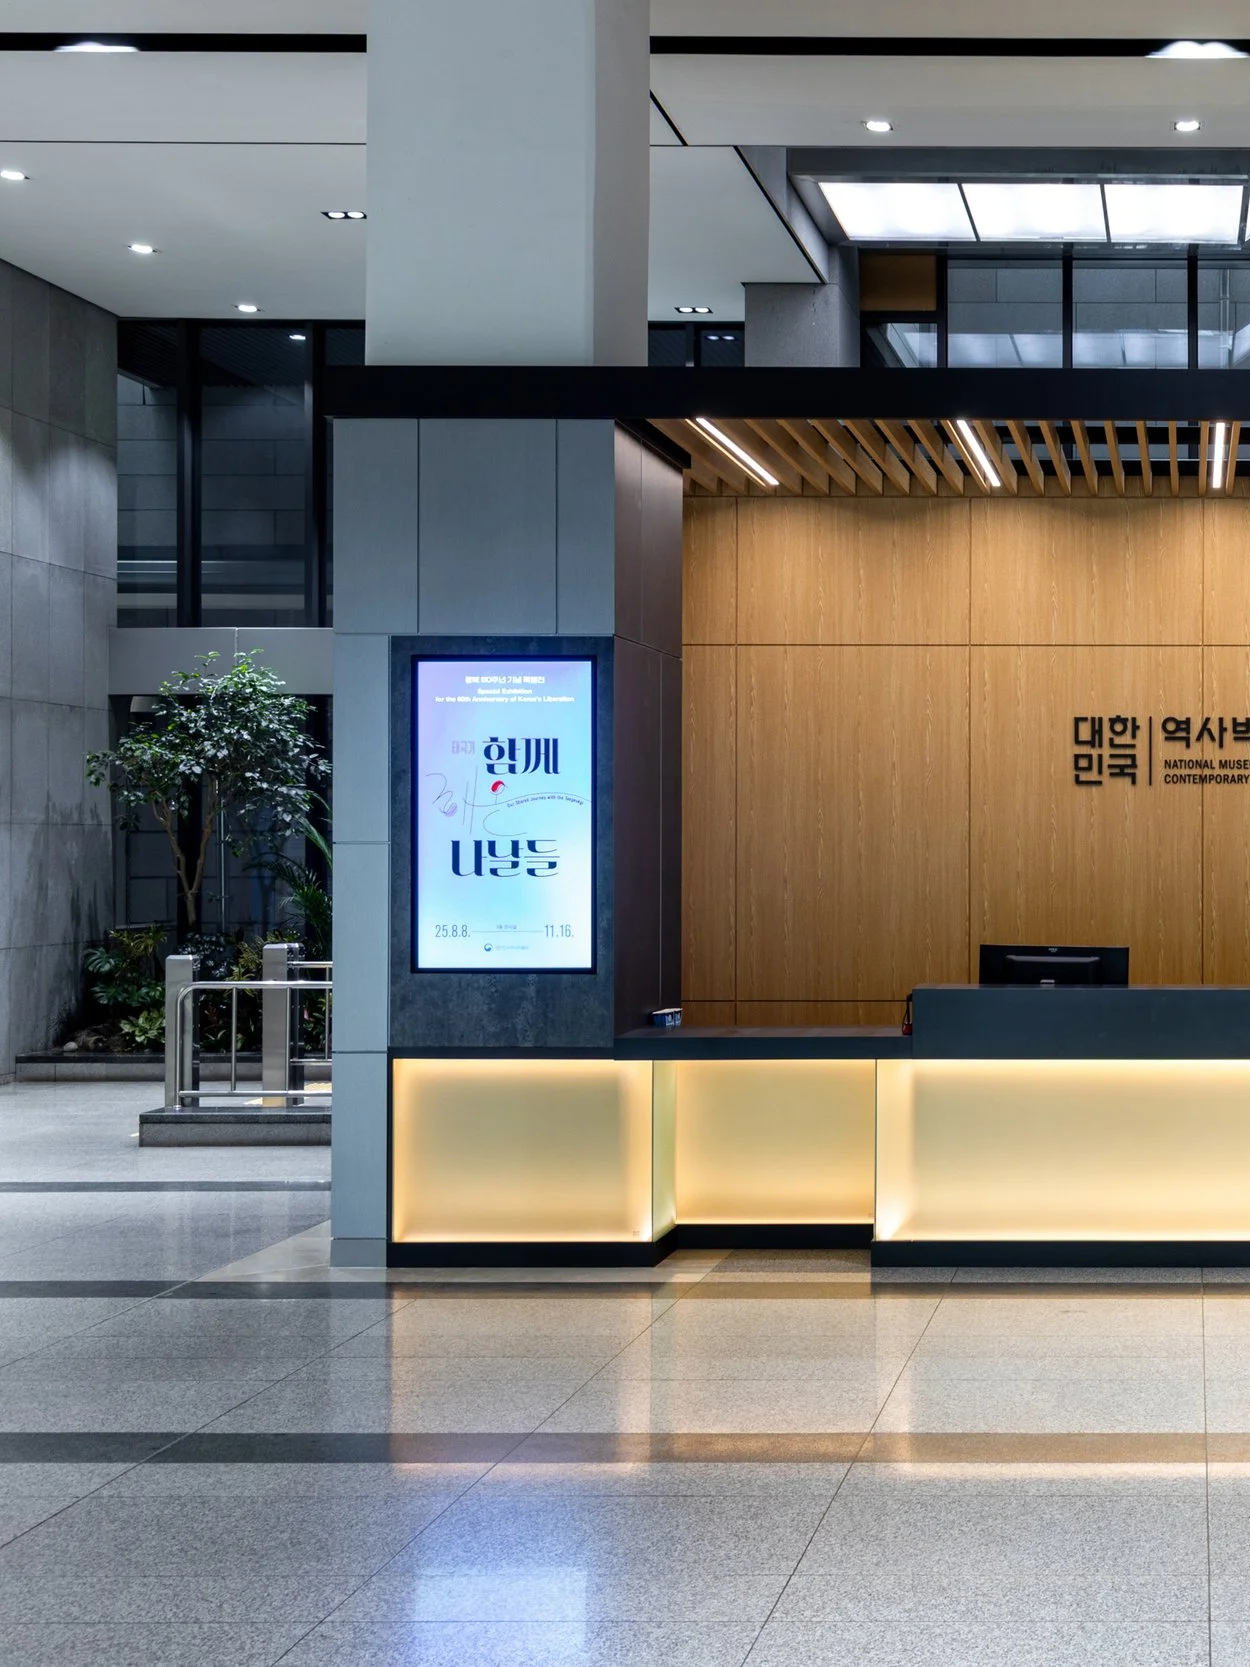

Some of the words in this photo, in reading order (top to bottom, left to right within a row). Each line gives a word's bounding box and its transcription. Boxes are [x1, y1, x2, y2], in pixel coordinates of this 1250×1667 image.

[1073, 715, 1140, 748] 대한
[482, 736, 561, 775] 함께
[1164, 759, 1216, 770] NATIONAL
[1073, 753, 1137, 786] 민국
[1164, 774, 1250, 785] CONTEMPORARY
[450, 839, 561, 877] 나날들
[435, 924, 470, 937] 25.8.8.
[544, 924, 574, 937] 11.16.
